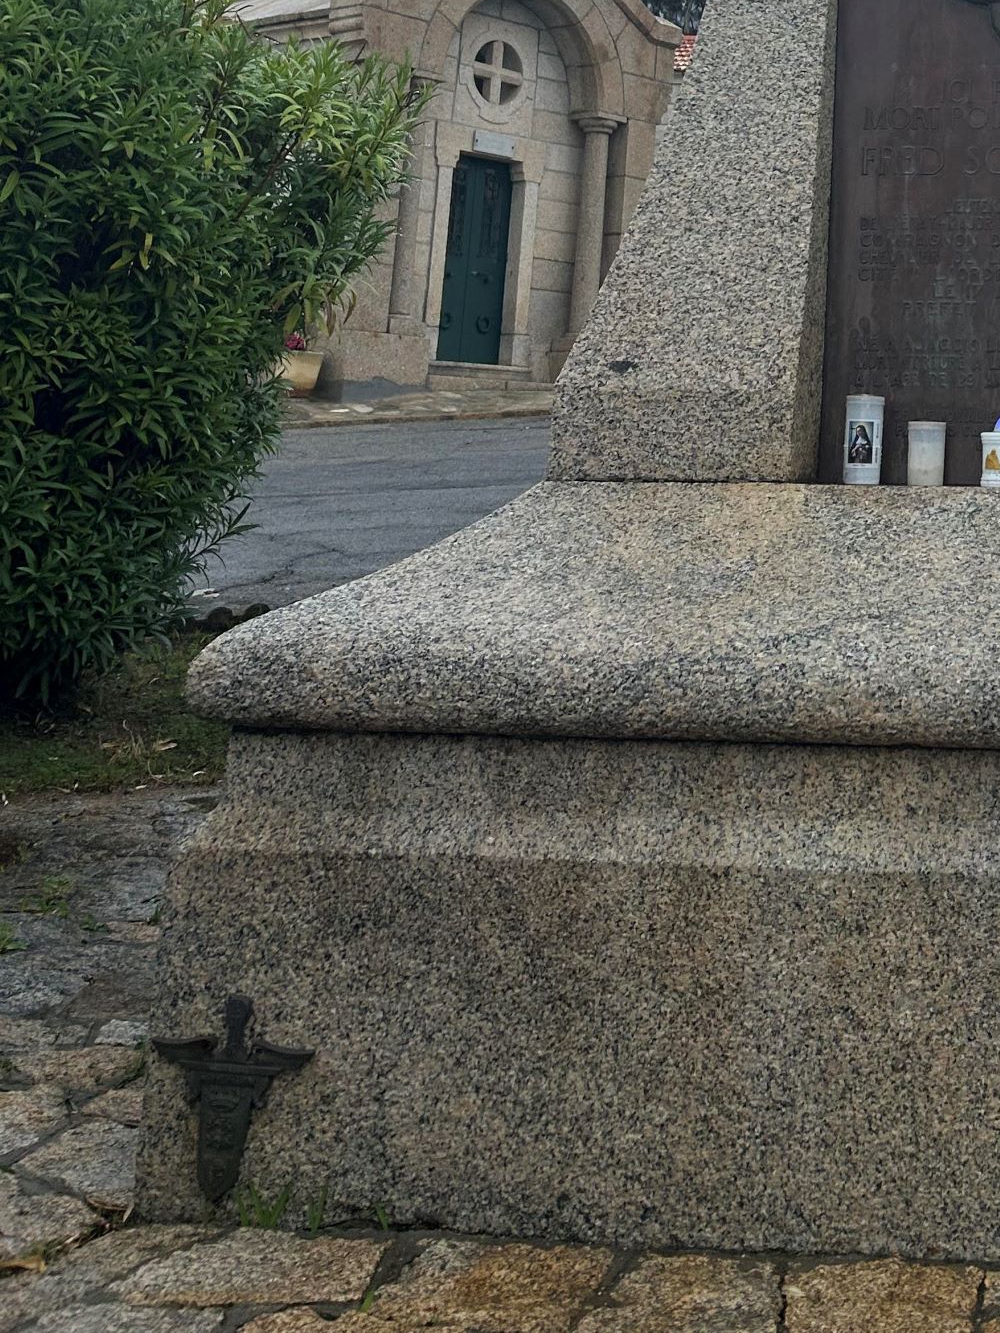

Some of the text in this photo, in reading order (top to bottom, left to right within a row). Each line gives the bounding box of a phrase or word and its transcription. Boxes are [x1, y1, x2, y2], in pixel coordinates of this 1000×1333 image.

[938, 79, 976, 103] ICI
[862, 106, 940, 130] MORT
[860, 146, 945, 176] FRED
[932, 283, 957, 299] LE
